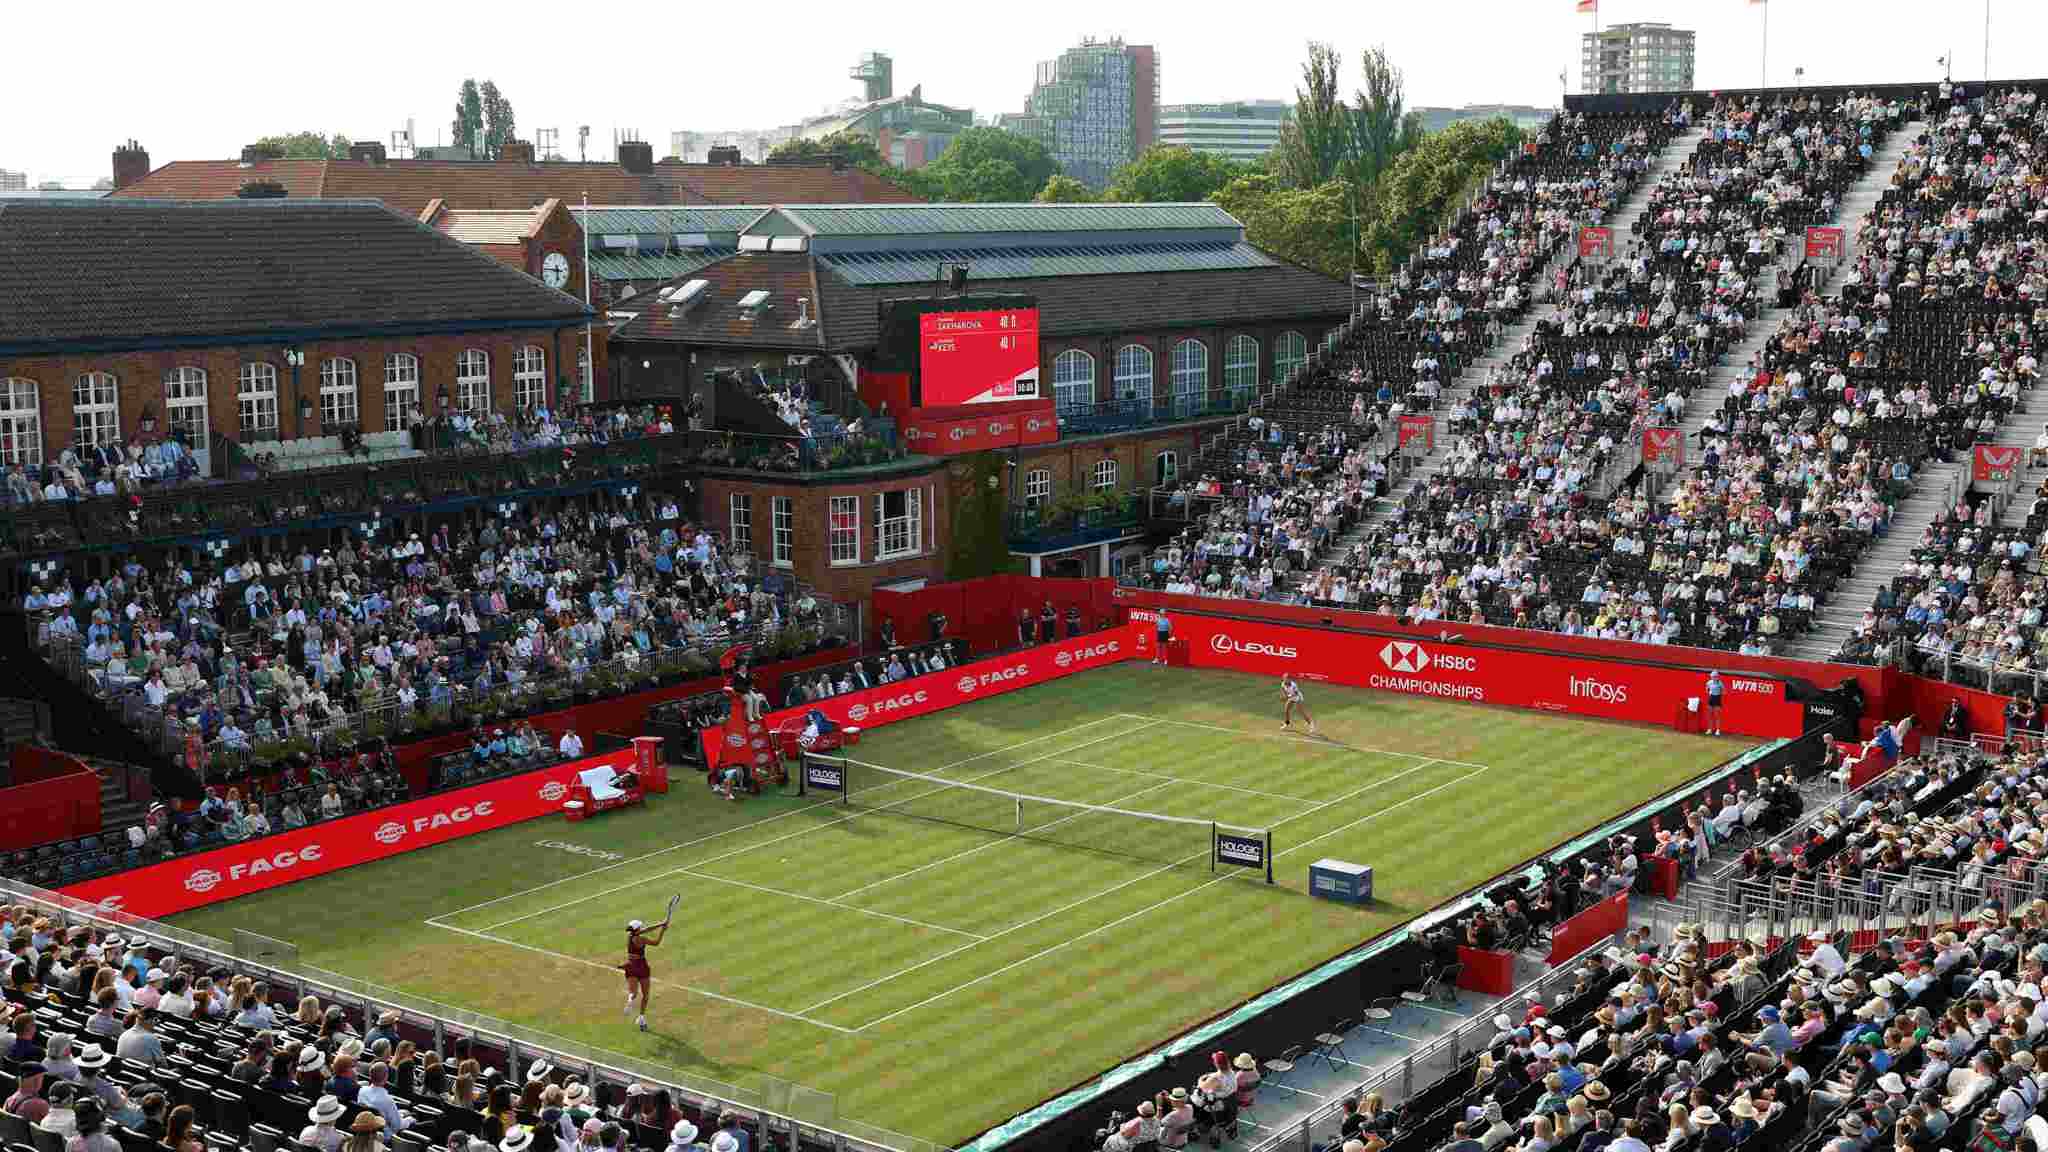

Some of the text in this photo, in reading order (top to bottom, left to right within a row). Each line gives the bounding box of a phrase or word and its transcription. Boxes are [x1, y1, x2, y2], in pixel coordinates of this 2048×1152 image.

[1074, 640, 1121, 661] FAGE
[1233, 640, 1297, 658] LEXUS
[1433, 653, 1477, 672] HSBC
[979, 663, 1029, 686] FAGE
[1368, 673, 1485, 700] CHAMPIONSHIPS
[1569, 674, 1628, 704] Infosys
[1731, 679, 1758, 693] WTA
[873, 689, 929, 713] FAGE
[1810, 704, 1835, 716] Haier
[809, 767, 841, 782] HOLOGIC
[412, 800, 496, 833] FAGE
[534, 839, 624, 861] LONDON
[1220, 839, 1261, 856] HOLOGIC
[229, 844, 322, 881] FAGE
